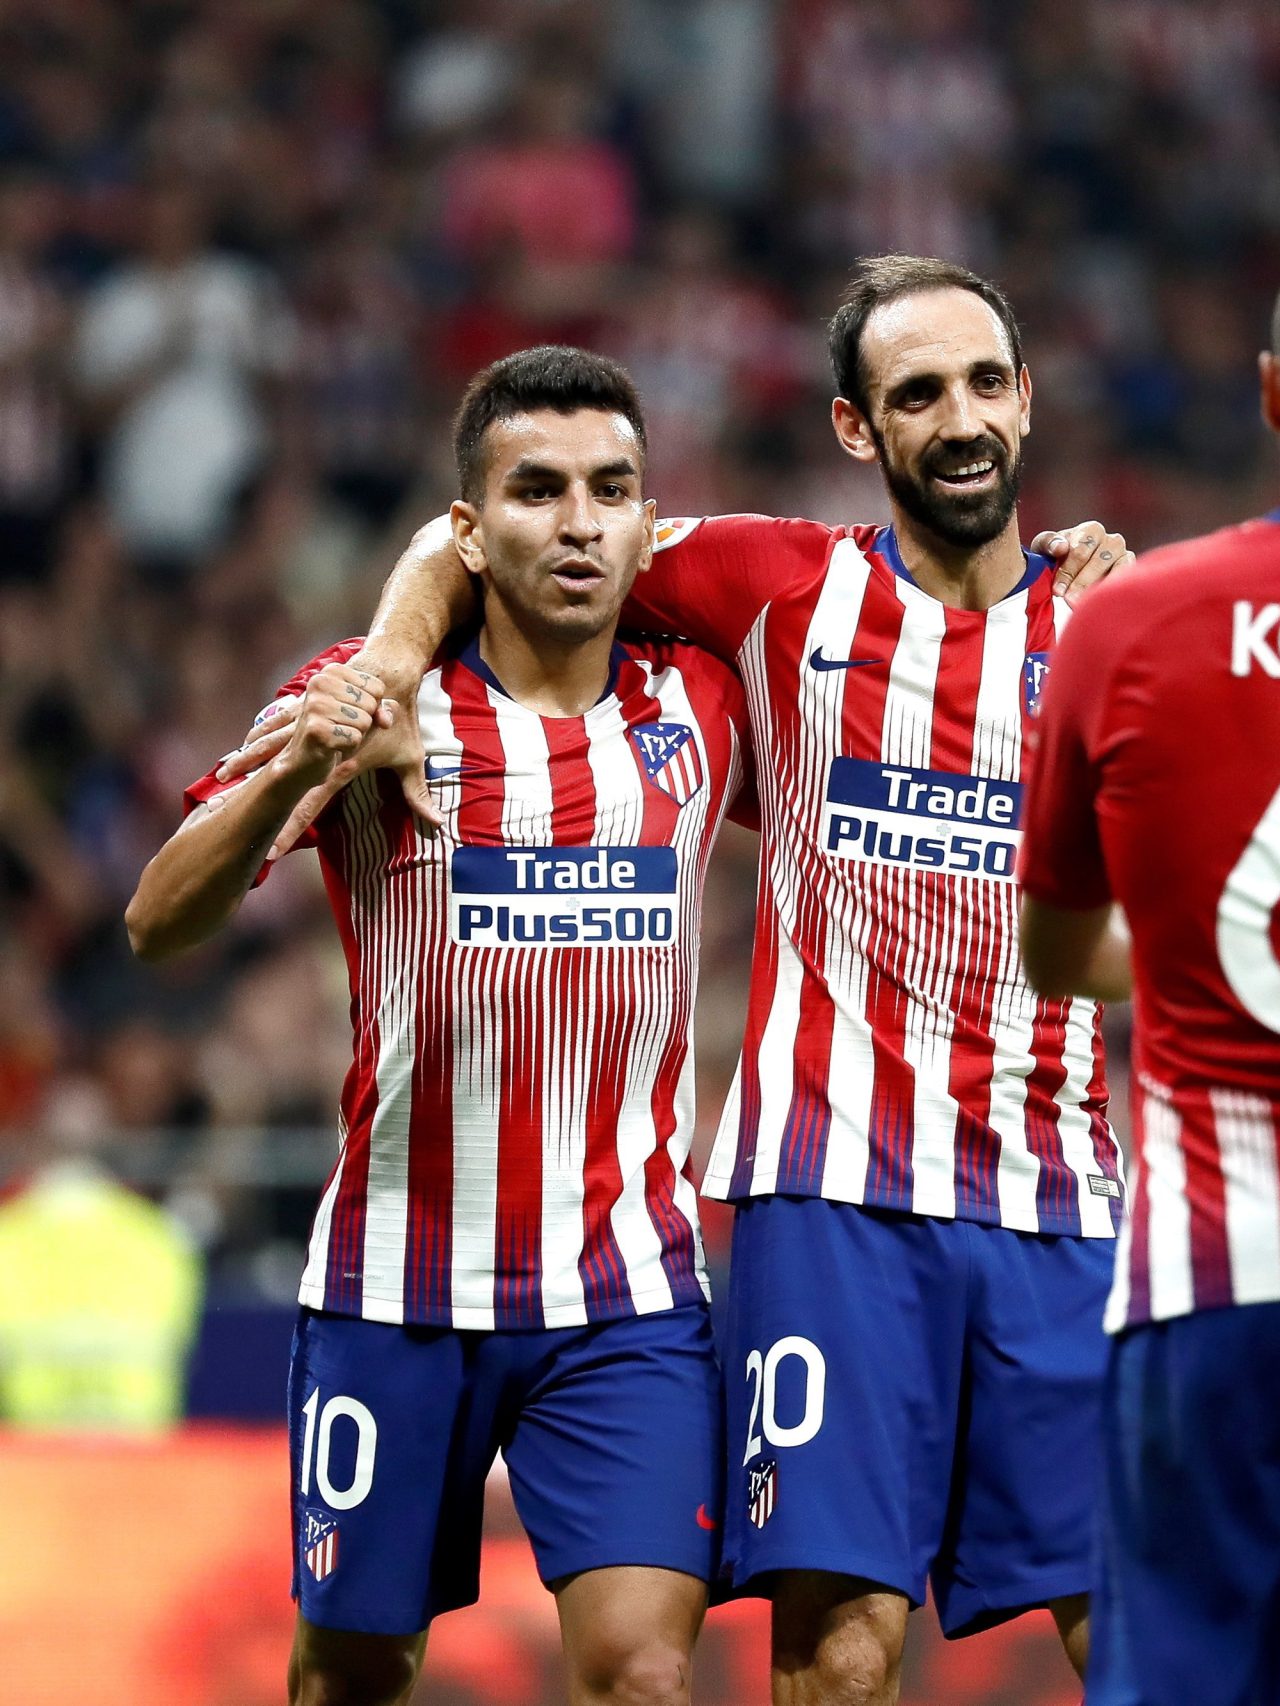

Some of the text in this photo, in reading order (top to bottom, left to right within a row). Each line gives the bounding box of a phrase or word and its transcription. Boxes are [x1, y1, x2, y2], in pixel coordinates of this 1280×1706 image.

[881, 769, 1014, 824] Trade
[506, 850, 636, 890] Trade
[458, 904, 673, 942] Plus500
[742, 1335, 826, 1467] 20
[300, 1386, 378, 1511] 10
